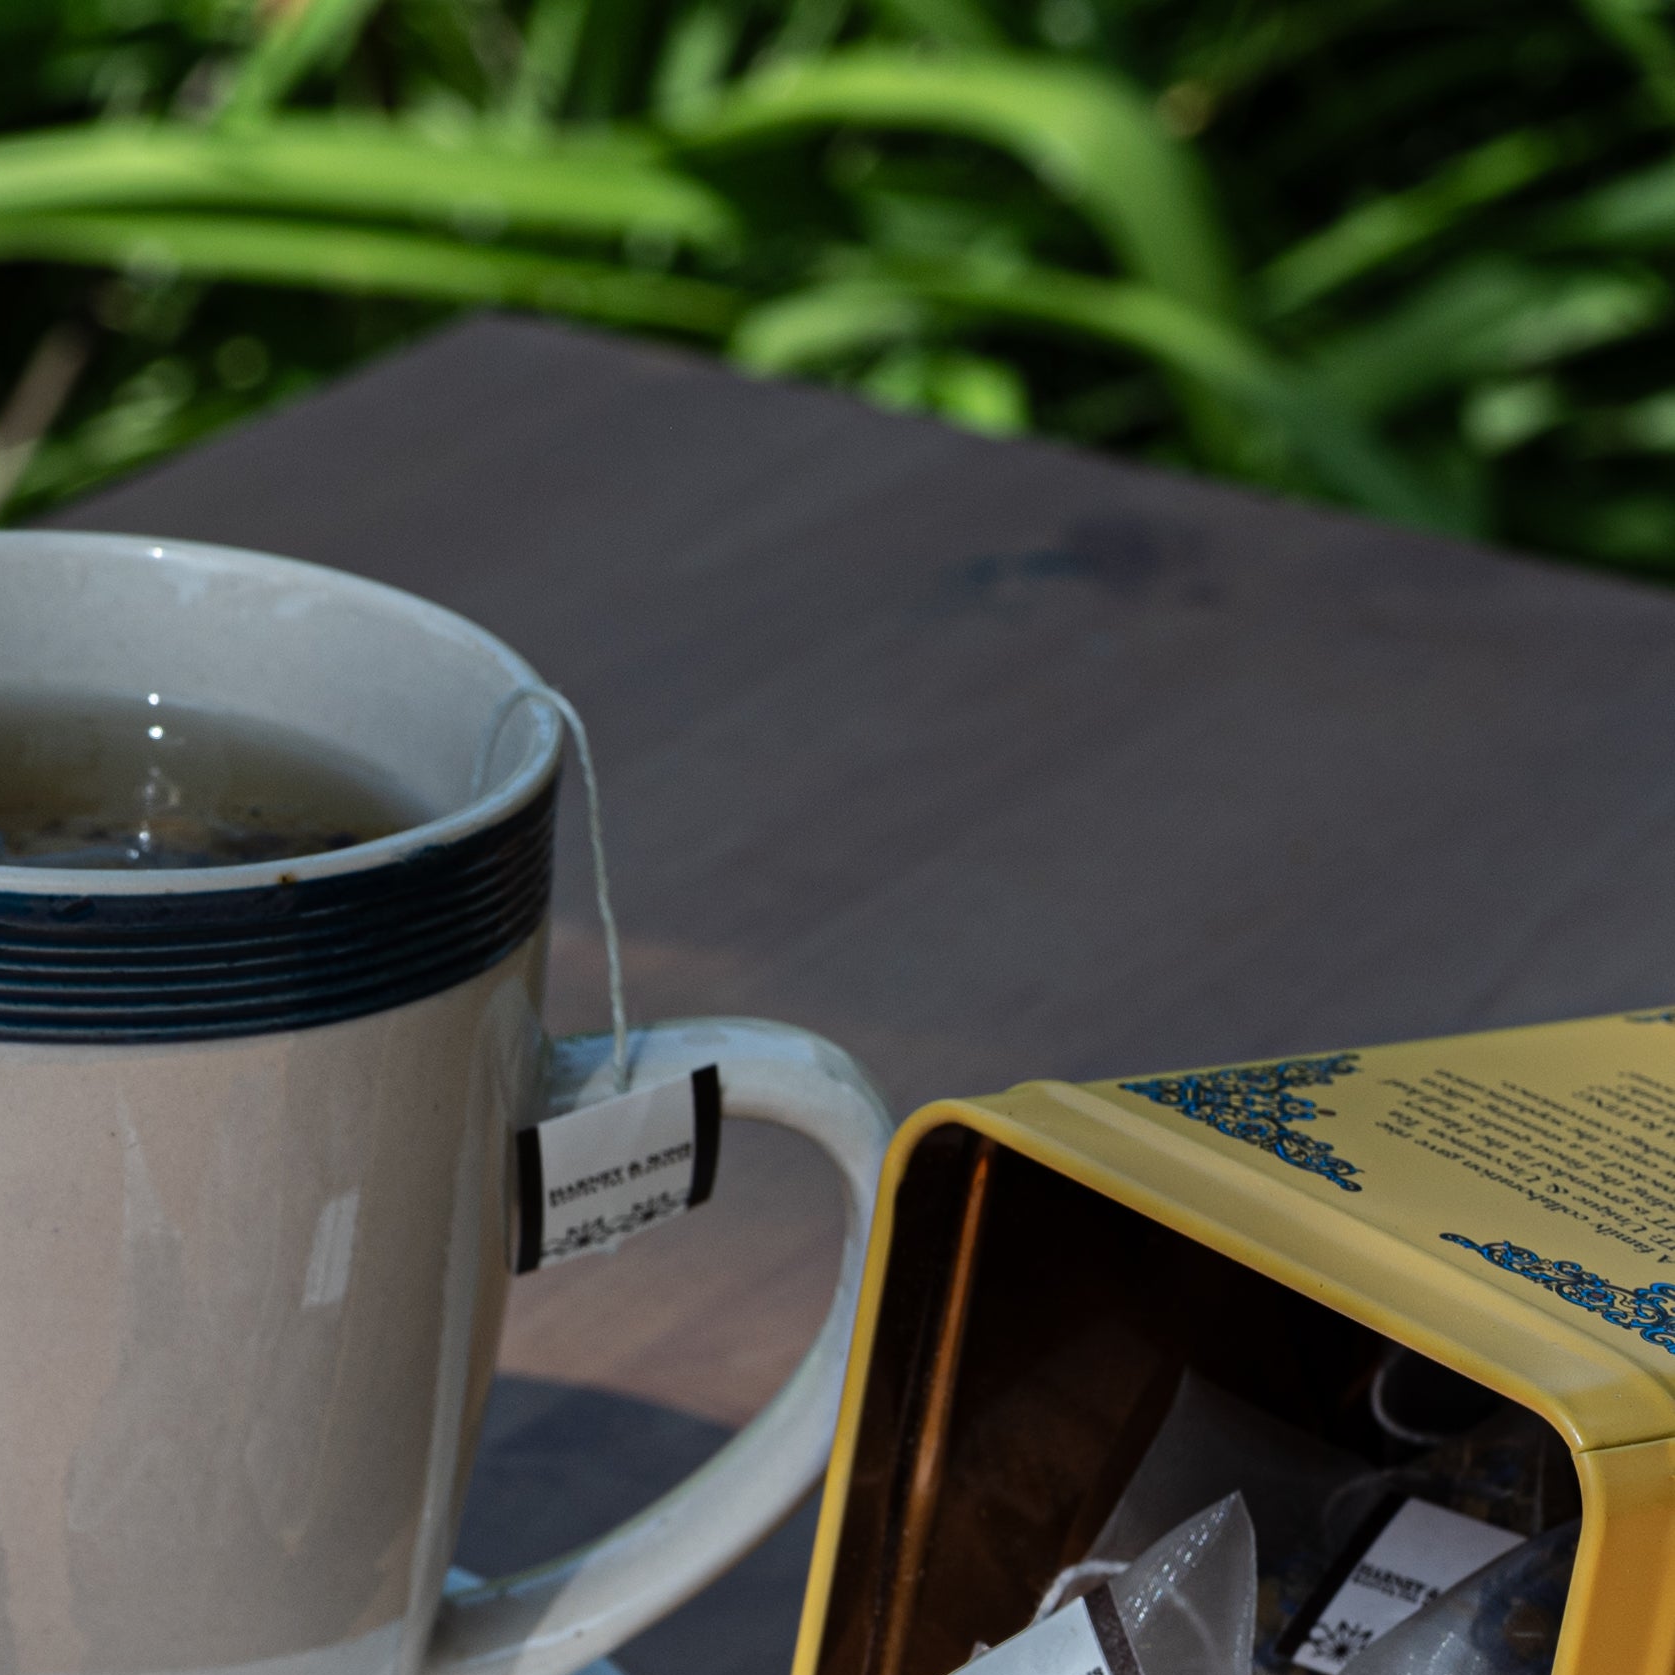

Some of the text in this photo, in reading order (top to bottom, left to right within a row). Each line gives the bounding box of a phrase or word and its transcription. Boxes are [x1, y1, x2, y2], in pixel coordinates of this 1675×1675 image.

[1428, 1128, 1541, 1184] Uncommon
[1462, 1160, 1589, 1222] collaboration
[1530, 1161, 1634, 1205] grounded
[1627, 1186, 1675, 1212] iding
[1572, 1195, 1647, 1234] Unique
[1590, 1222, 1655, 1254] family
